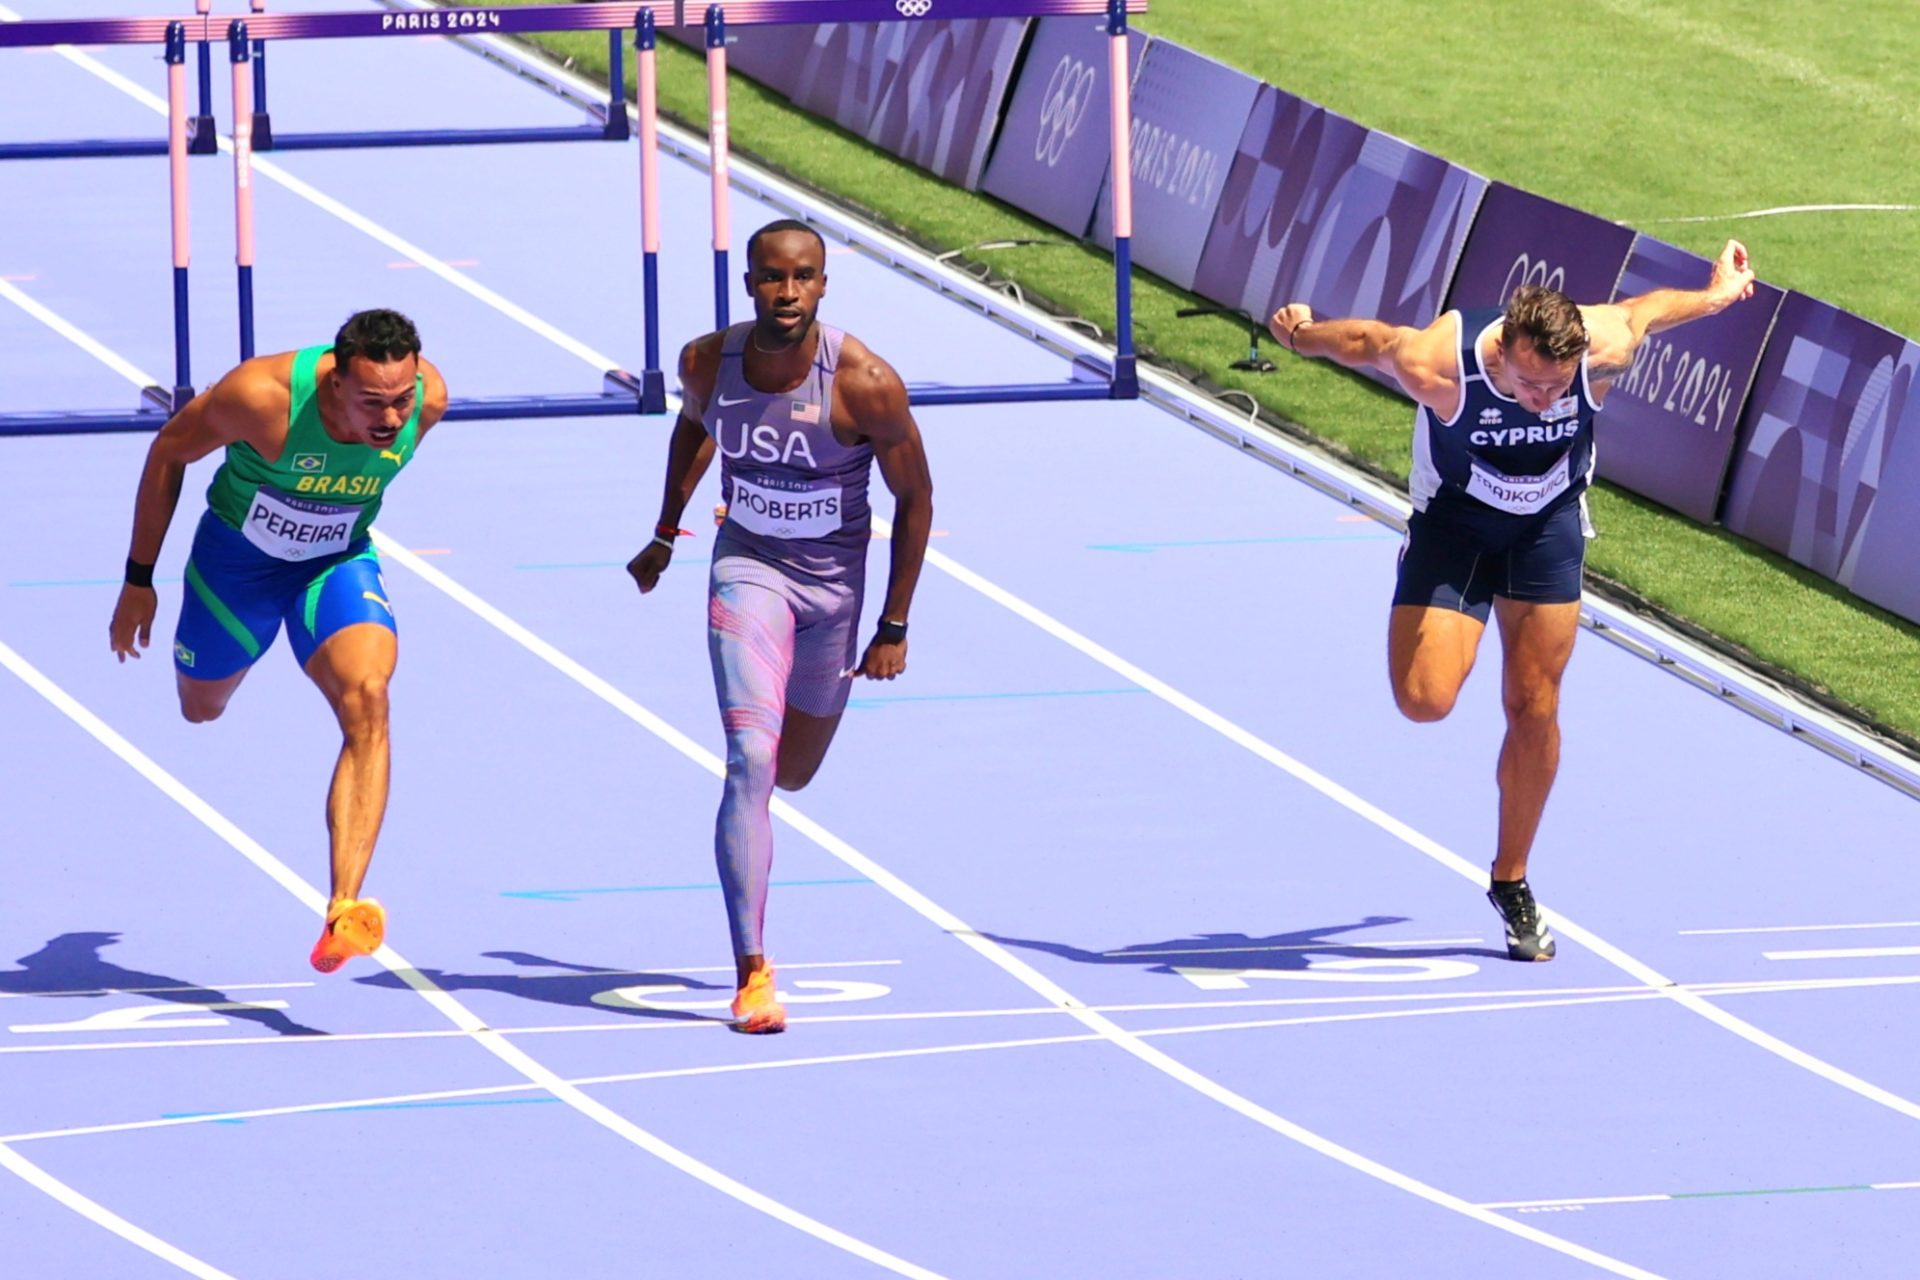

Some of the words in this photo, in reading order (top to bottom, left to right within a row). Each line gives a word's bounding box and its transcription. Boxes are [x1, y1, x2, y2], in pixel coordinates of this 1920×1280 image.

[382, 13, 440, 30] PARIS
[447, 11, 500, 28] 2024
[1663, 350, 1732, 433] 2024
[715, 417, 817, 468] USA
[1470, 419, 1580, 447] CYPRUS
[295, 475, 382, 496] BRASIL
[737, 485, 838, 521] ROBERTS
[252, 504, 348, 544] PEREIRA
